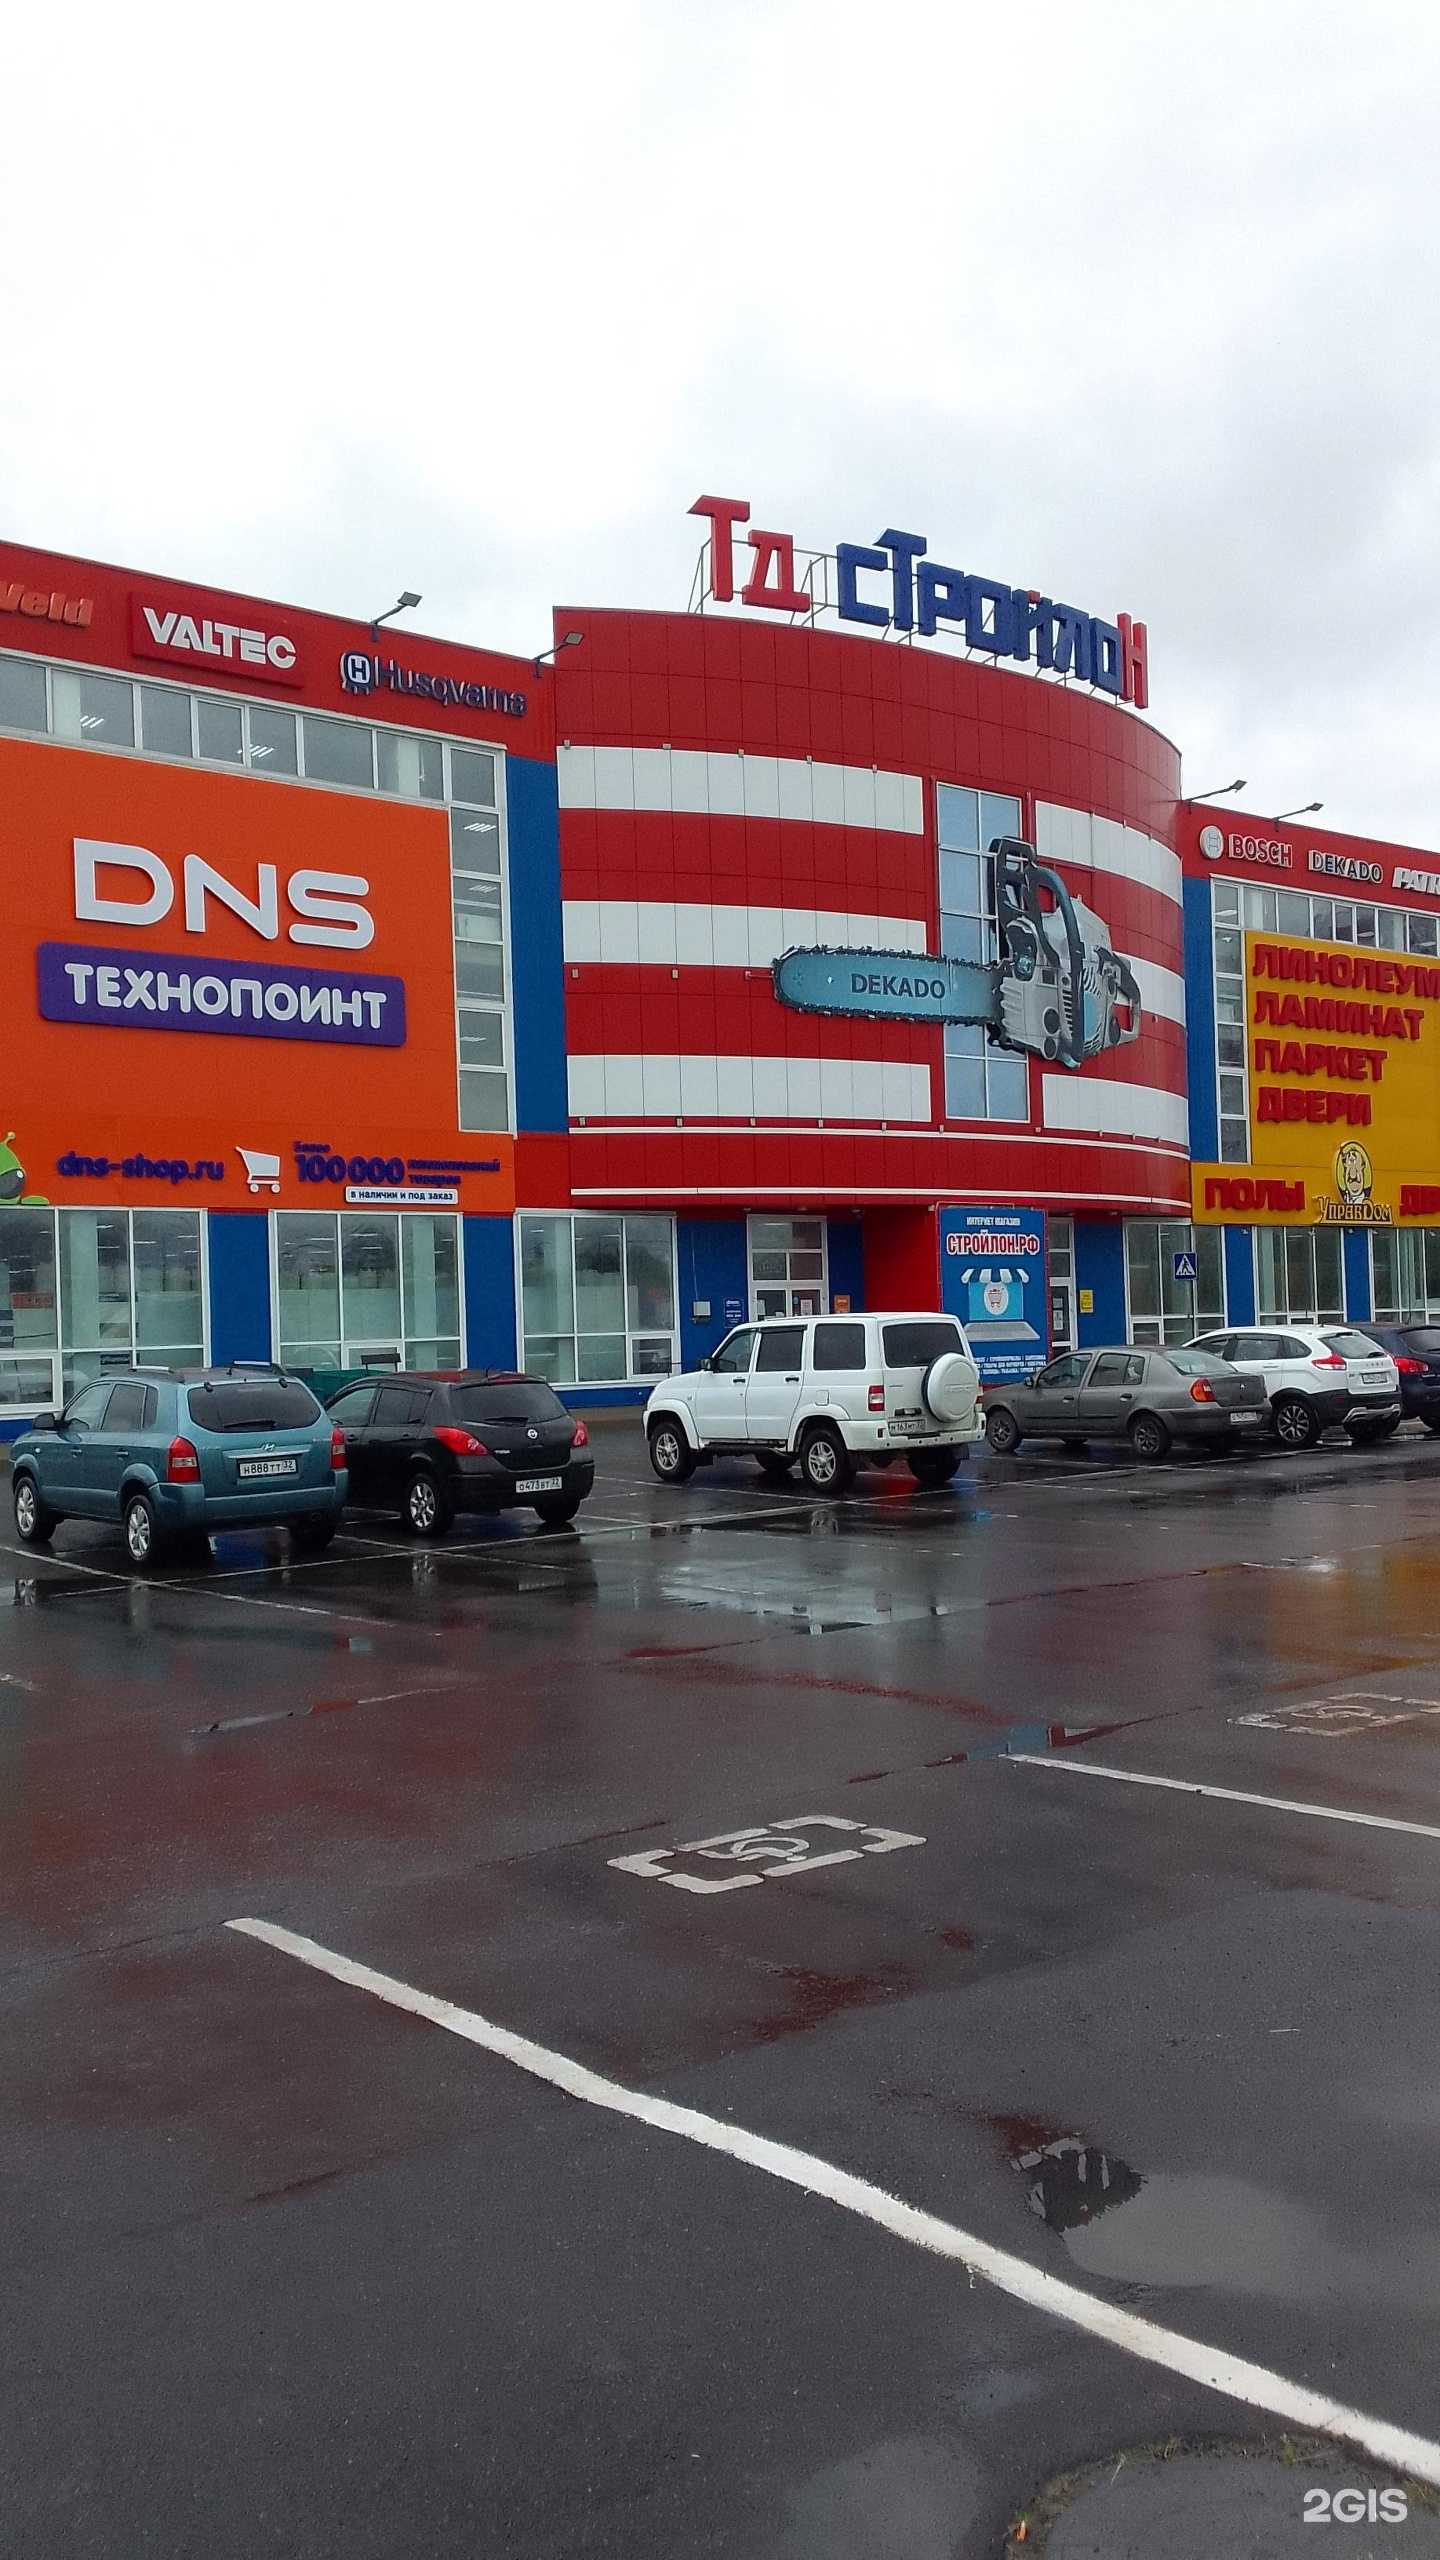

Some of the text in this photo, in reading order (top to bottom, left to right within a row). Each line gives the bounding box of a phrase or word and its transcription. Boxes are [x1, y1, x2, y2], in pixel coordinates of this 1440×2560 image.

[142, 607, 297, 669] VALTEC
[374, 655, 528, 717] Husqvarna
[1229, 834, 1293, 868] BOSCH
[1308, 850, 1383, 884] DEKADO
[73, 838, 375, 949] DNS
[851, 973, 946, 999] DEKADO
[1253, 943, 1440, 1000] ЛИНОЛЕУМ
[64, 963, 387, 1029] ТЕХНОПОИНТ
[1254, 990, 1425, 1040] ЛАМИНАТ
[1254, 1038, 1388, 1081] ПАРКЕТ
[1256, 1086, 1372, 1126] ДВЕРИ
[57, 1151, 225, 1185] dns-shop.ru
[359, 1191, 398, 1199] наличии
[408, 1192, 426, 1201] под
[428, 1192, 453, 1201] заказ
[1204, 1178, 1306, 1212] ПОЛЫ
[946, 1229, 1040, 1255] СТРОЙЛОН.РФ
